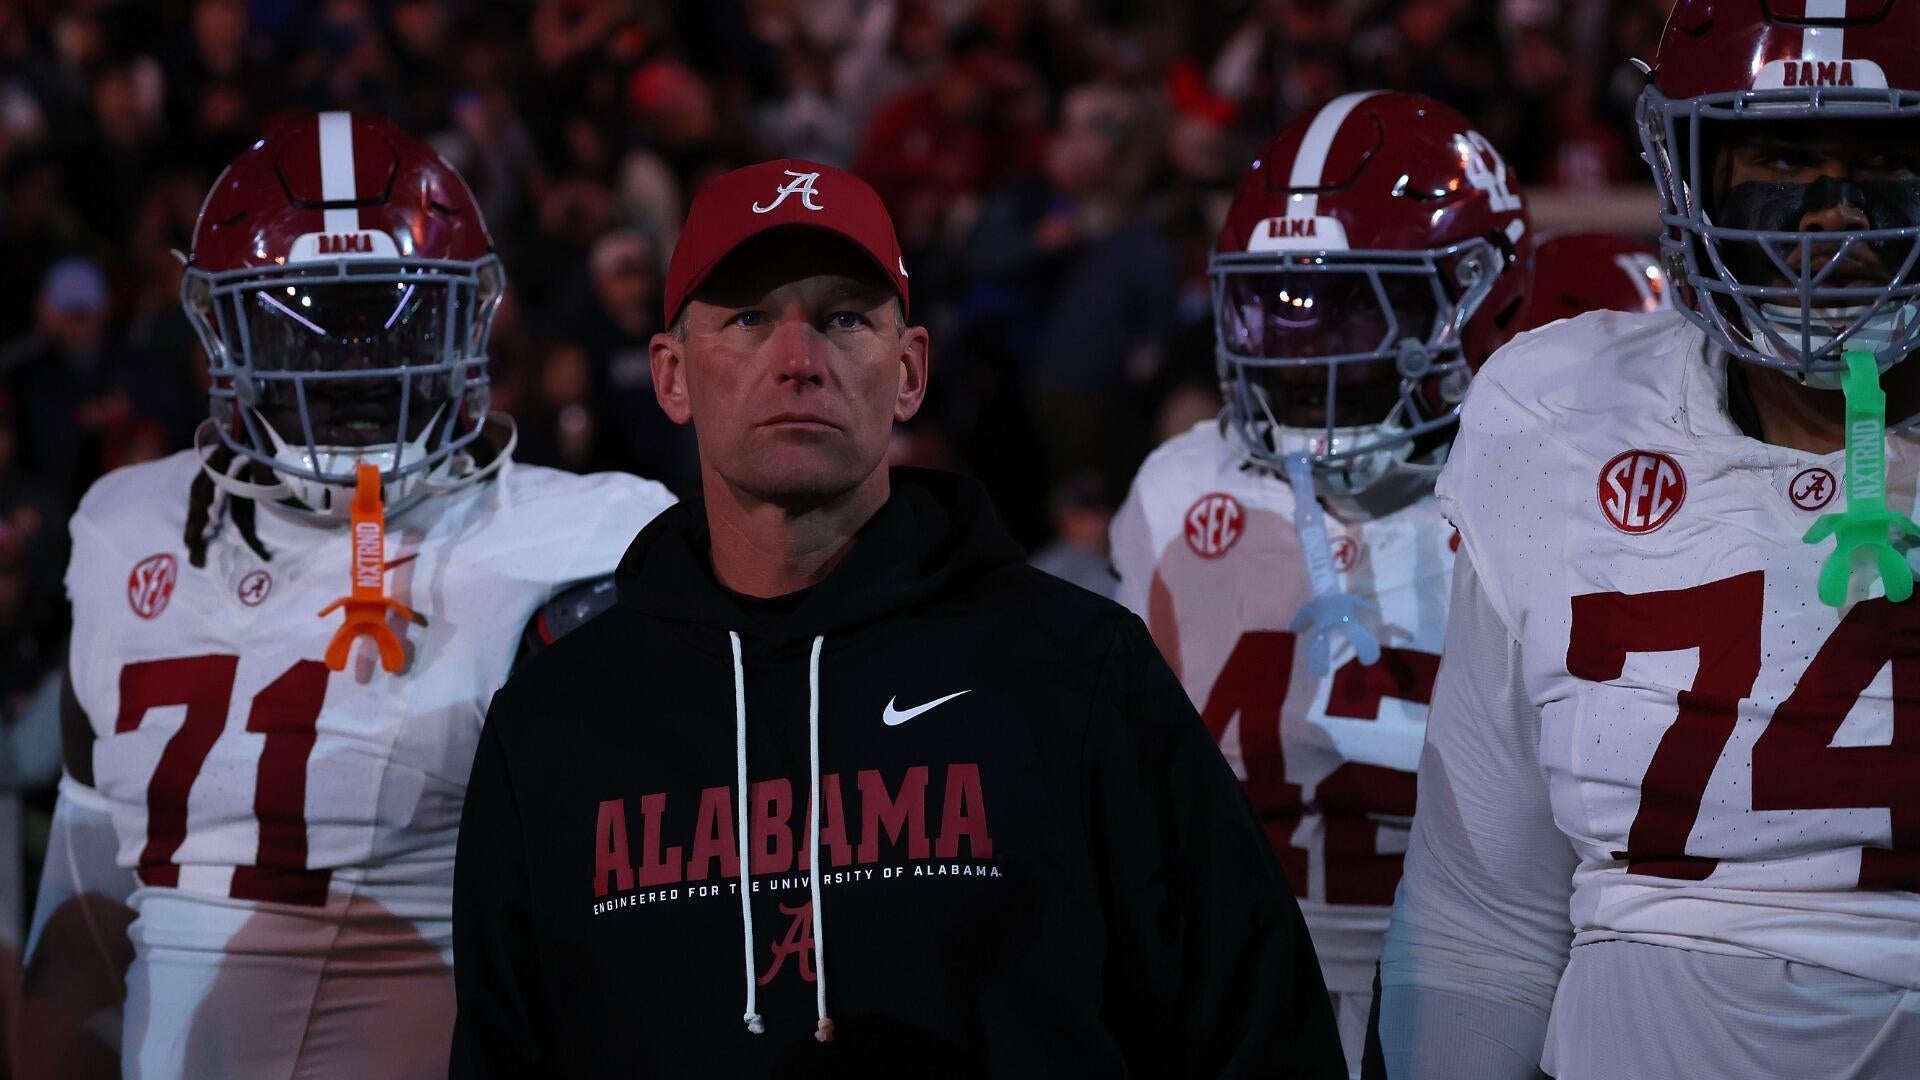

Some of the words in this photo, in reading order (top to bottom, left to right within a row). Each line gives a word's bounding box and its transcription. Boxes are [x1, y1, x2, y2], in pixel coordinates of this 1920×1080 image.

[1783, 61, 1854, 87] BAMA
[752, 169, 824, 214] A
[319, 233, 374, 253] BAMA
[1268, 219, 1316, 237] BAMA
[1793, 468, 1831, 502] A
[1852, 419, 1881, 499] NXTRND
[1605, 454, 1679, 530] SEC
[357, 522, 381, 588] NXTRND
[1187, 496, 1243, 556] SEC
[1567, 570, 1920, 891] 74
[115, 654, 332, 907] 71
[593, 762, 993, 897] ALABAMA
[593, 889, 679, 916] ENGINEERED
[689, 884, 719, 898] FOR
[729, 881, 760, 895] TE
[770, 869, 873, 890] UNIVRSITY
[883, 867, 904, 879] OF
[757, 899, 818, 987] A
